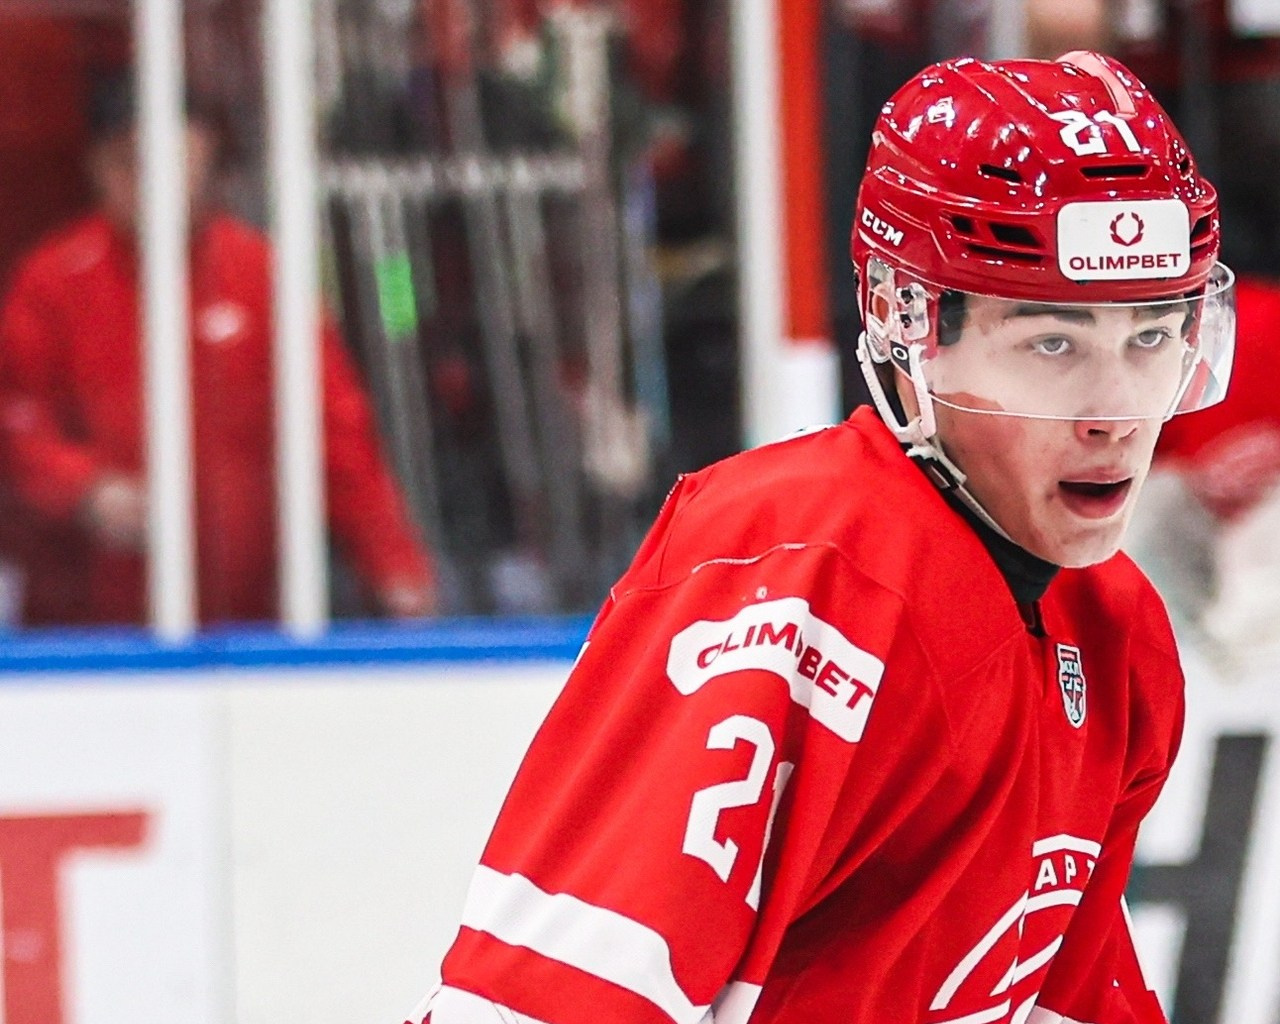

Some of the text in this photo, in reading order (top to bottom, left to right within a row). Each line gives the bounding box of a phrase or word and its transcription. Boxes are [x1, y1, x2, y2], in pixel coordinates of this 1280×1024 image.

[1049, 110, 1142, 156] 21
[861, 206, 905, 247] CCM
[1069, 253, 1182, 271] OLIMPBET
